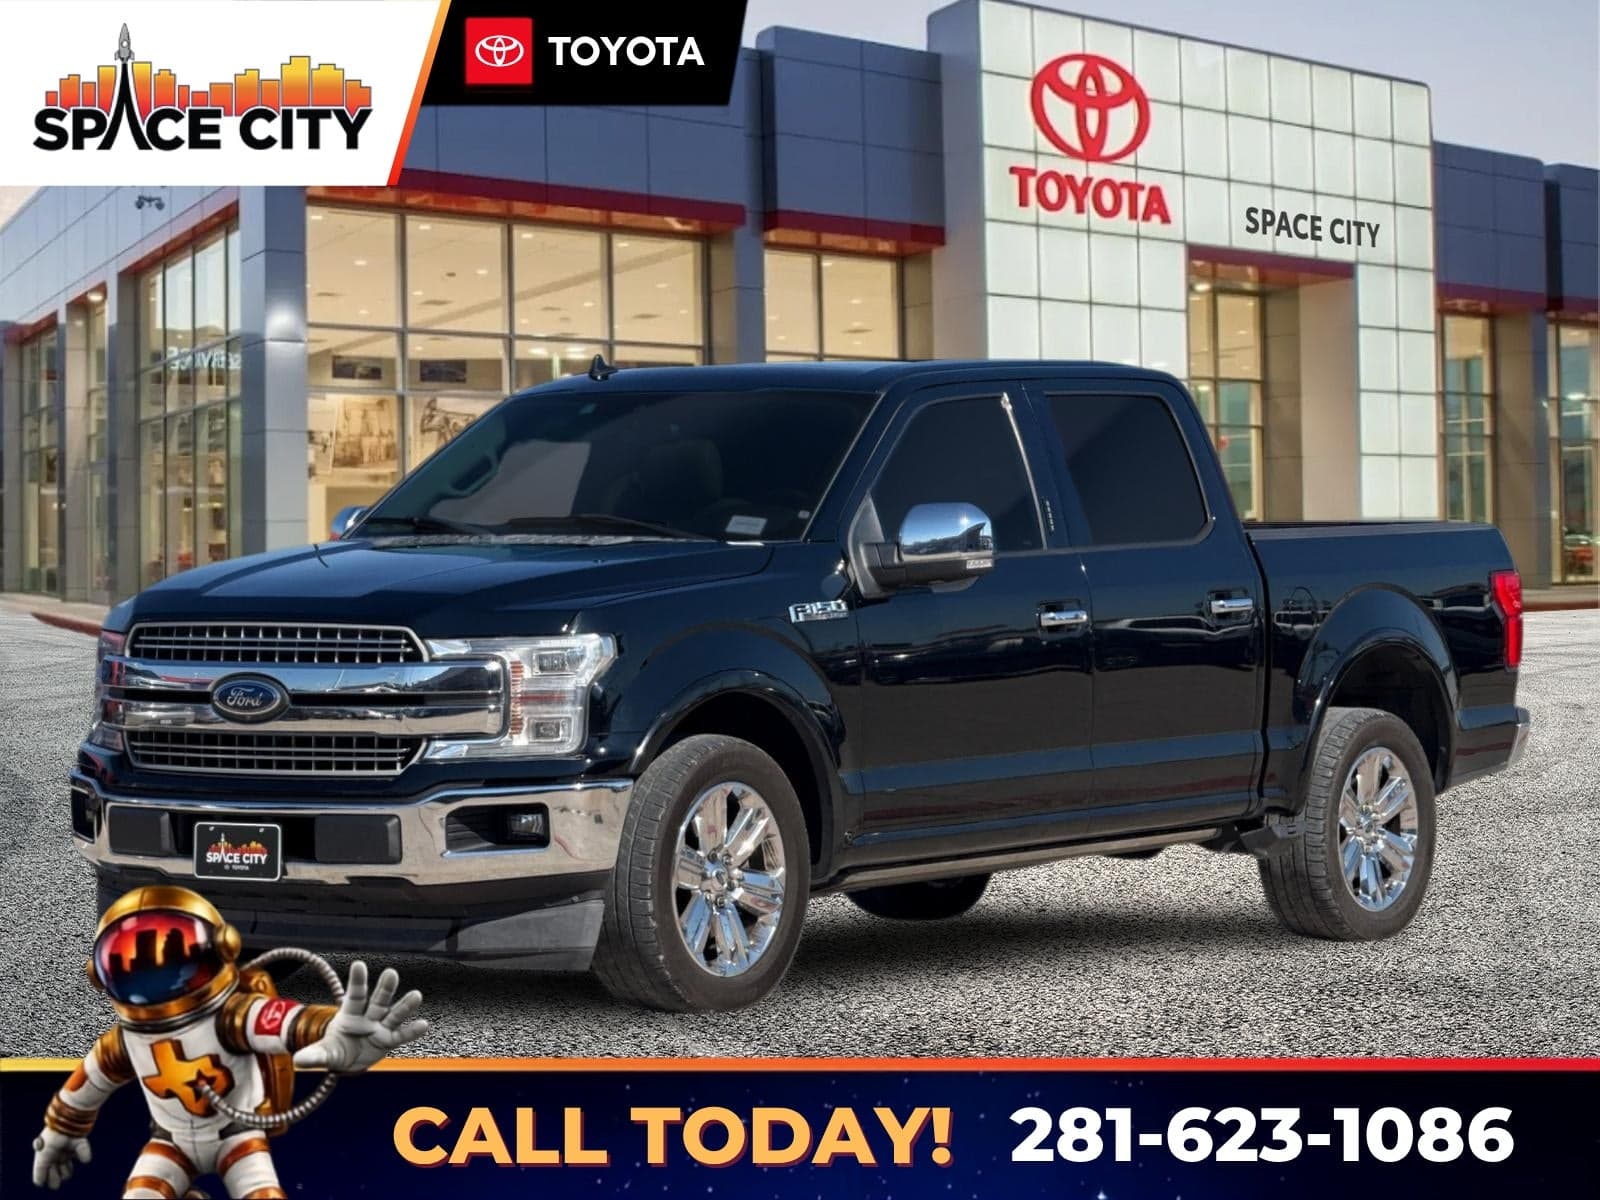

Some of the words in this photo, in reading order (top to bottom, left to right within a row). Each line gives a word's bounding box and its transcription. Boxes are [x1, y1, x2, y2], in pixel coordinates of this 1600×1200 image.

[1009, 166, 1171, 224] TOYOTA
[1245, 206, 1322, 242] SPACE
[1329, 217, 1381, 248] CITY
[226, 687, 264, 707] Ford
[206, 851, 240, 864] SPACE
[242, 853, 268, 864] CITY
